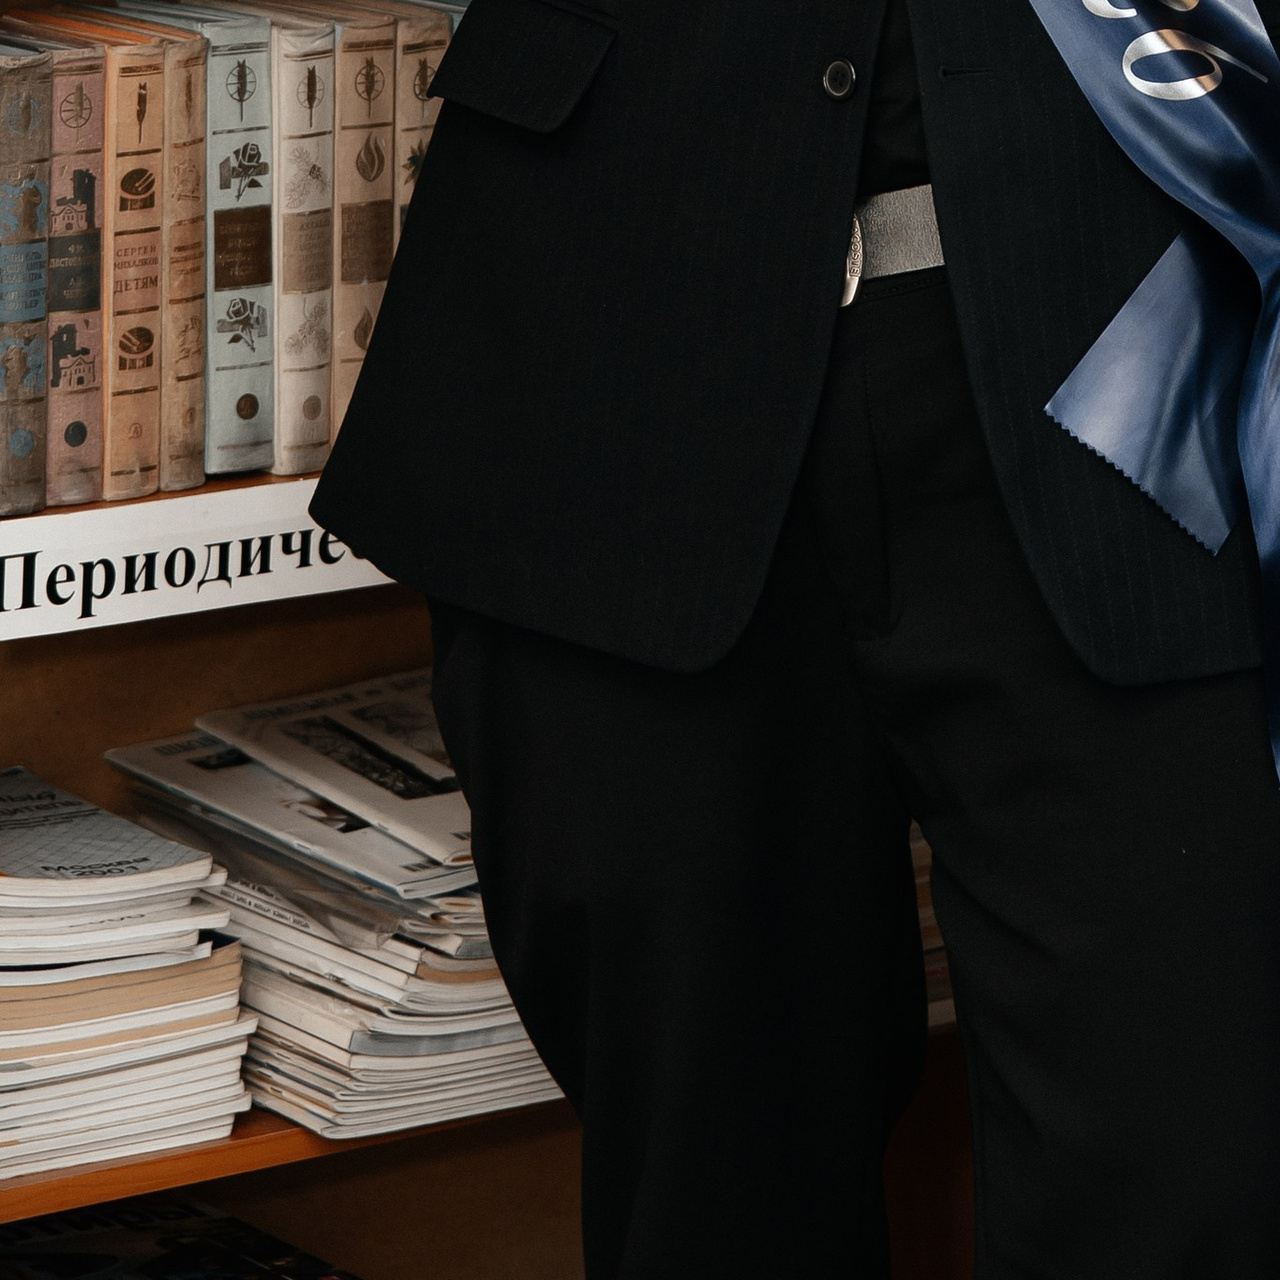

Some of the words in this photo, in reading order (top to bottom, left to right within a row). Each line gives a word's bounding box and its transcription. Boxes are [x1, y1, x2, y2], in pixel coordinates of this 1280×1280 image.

[115, 244, 157, 258] СЕРГЕЙ
[113, 274, 159, 294] ДЕТЯМ
[0, 526, 366, 620] Периодиче
[70, 864, 141, 877] 2001
